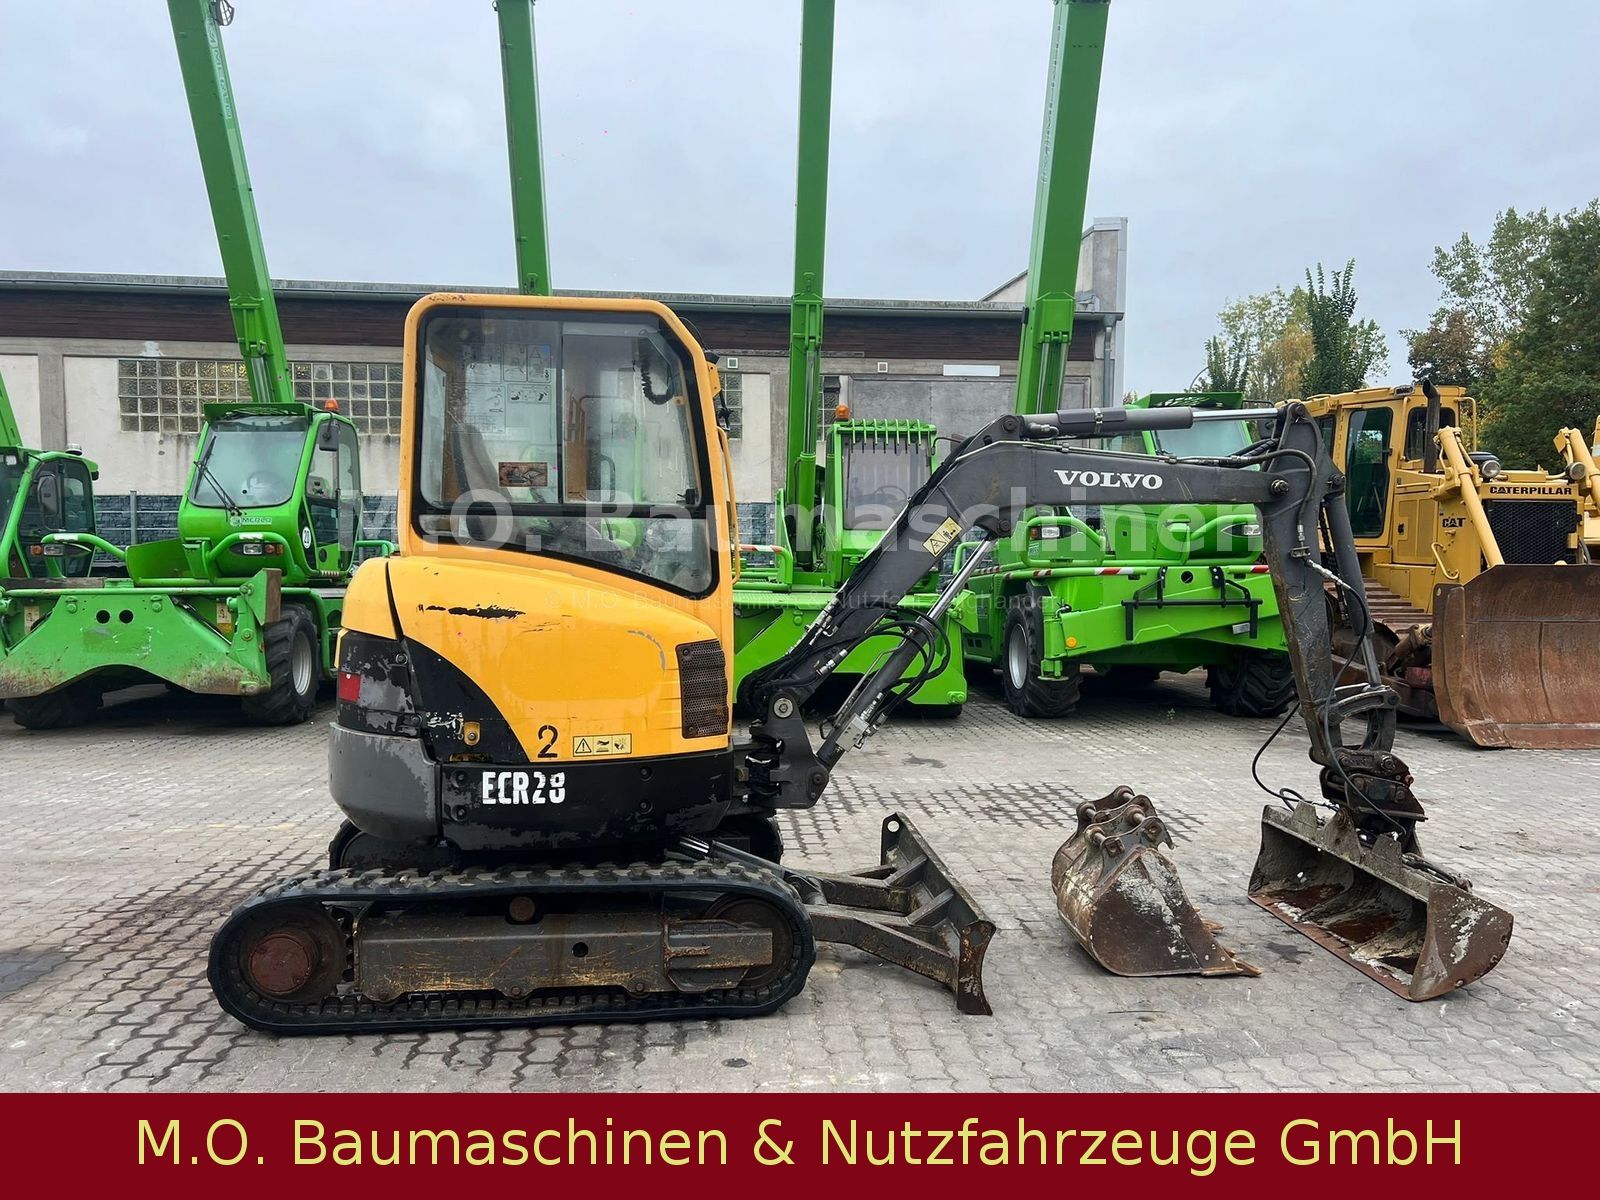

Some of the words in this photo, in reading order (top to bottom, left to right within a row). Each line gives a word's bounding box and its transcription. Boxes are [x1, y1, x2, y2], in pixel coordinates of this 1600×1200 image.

[1054, 469, 1163, 490] VOLVO
[1489, 486, 1573, 496] CATERPILLAR
[1442, 517, 1467, 528] CAT
[537, 725, 559, 758] 2
[482, 771, 566, 804] ECR28
